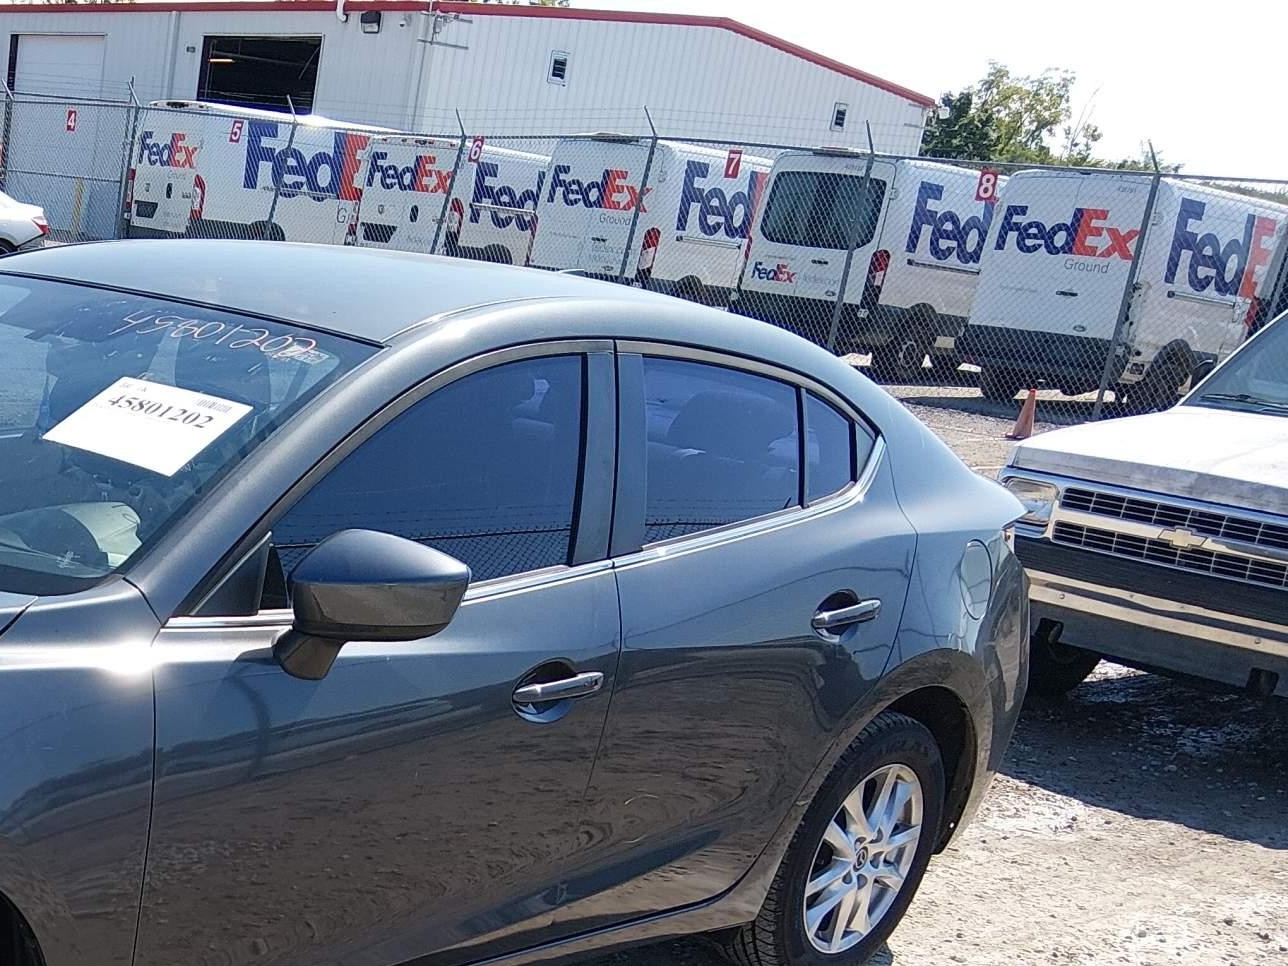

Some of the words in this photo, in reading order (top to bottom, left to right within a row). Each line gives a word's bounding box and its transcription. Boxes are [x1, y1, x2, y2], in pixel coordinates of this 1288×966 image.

[68, 112, 76, 130] 4
[232, 122, 242, 140] 5
[139, 131, 198, 169] FedEx
[470, 139, 481, 161] 6
[728, 153, 741, 175] 7
[367, 151, 454, 194] FedEx
[979, 173, 995, 198] 8
[469, 162, 546, 232] Fed
[547, 164, 653, 213] FedEx
[599, 213, 631, 226] Ground
[905, 181, 994, 264] Fed
[994, 205, 1141, 261] FedEx
[751, 261, 797, 283] FedEx
[1063, 258, 1111, 274] Ground
[108, 310, 317, 358] 45801202
[108, 394, 214, 428] 45801202
